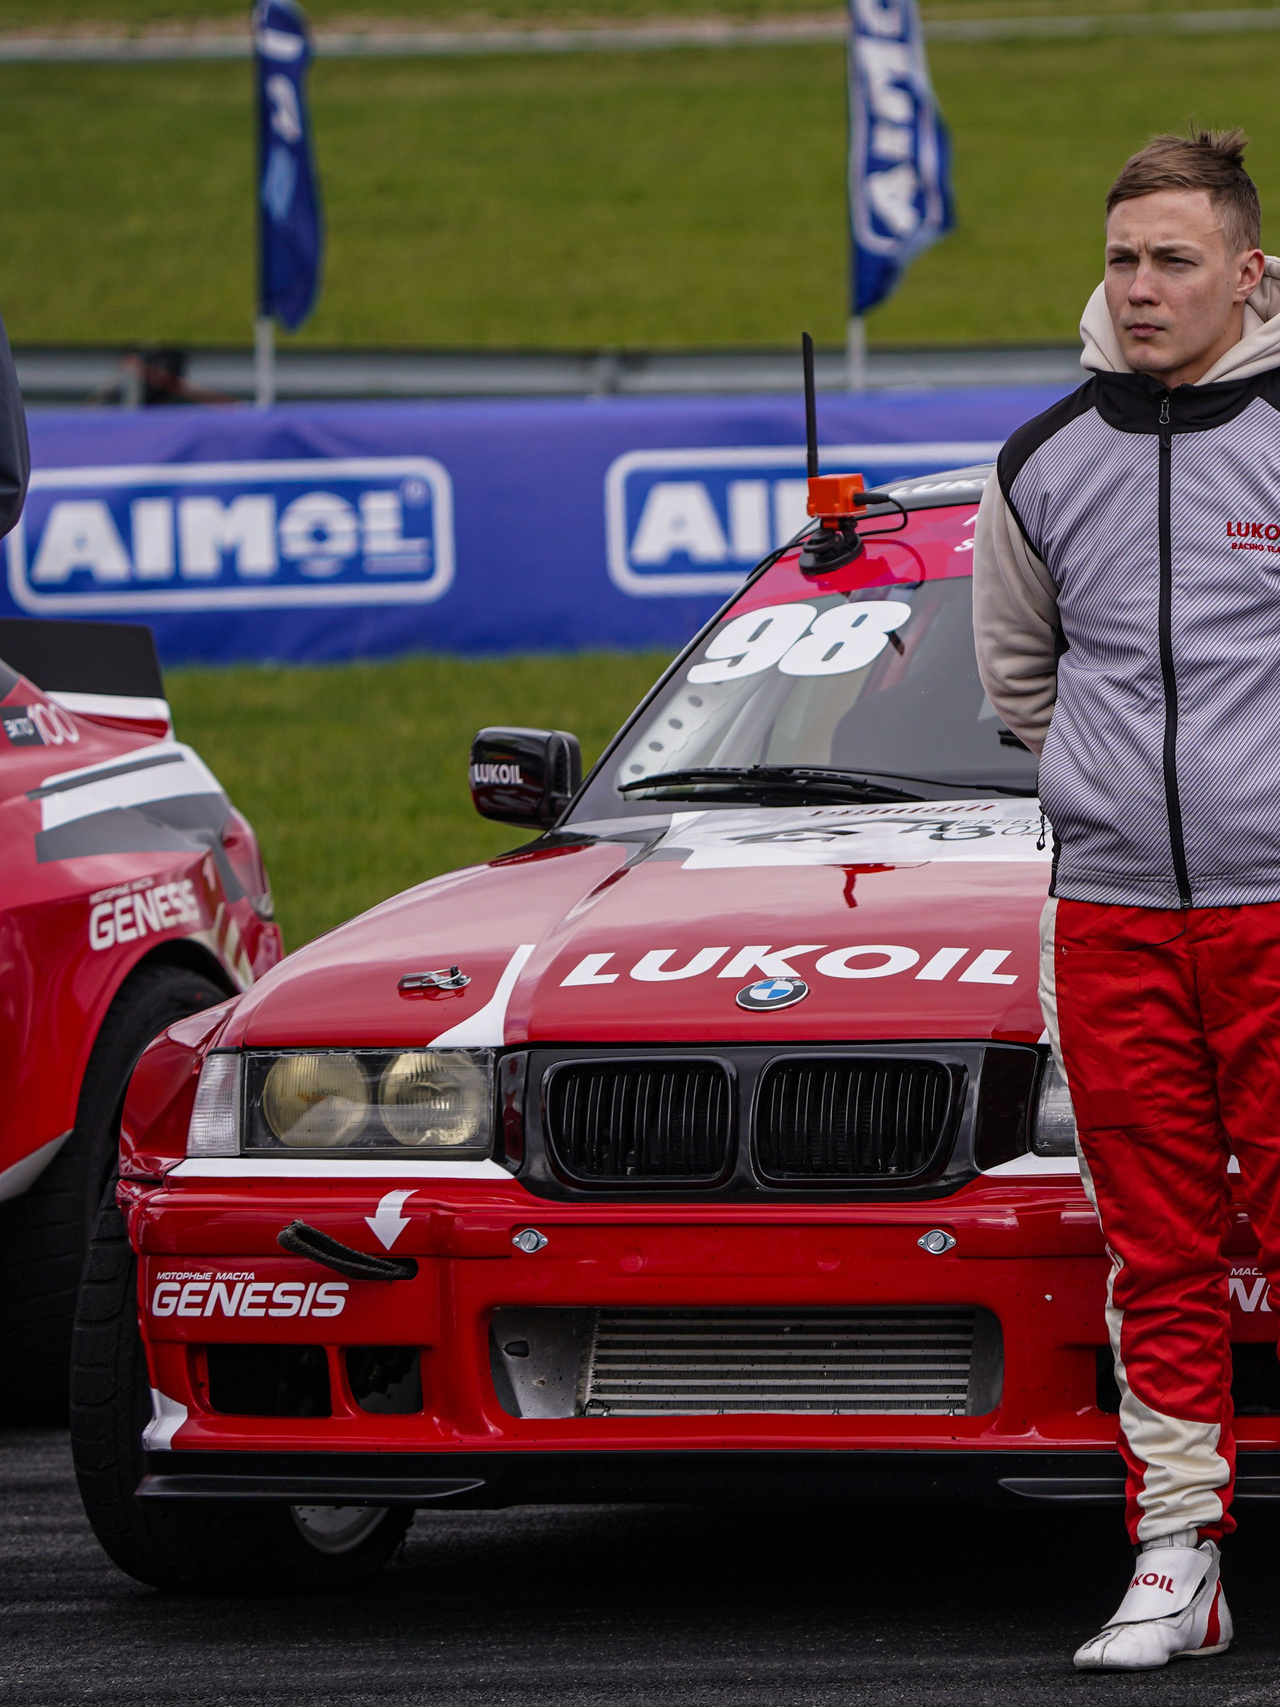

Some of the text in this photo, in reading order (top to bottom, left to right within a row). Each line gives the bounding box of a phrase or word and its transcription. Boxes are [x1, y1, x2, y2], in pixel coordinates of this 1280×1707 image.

[31, 492, 430, 583] AIMOL
[1231, 542, 1264, 551] RACING
[687, 601, 912, 684] 98
[27, 703, 79, 746] 100
[473, 763, 523, 786] LUKOIL
[89, 879, 200, 951] GENESIS
[559, 945, 1019, 987] LUKOIL
[156, 1271, 255, 1281] МОТОРНЫЕ МАСЛА
[1230, 1267, 1263, 1276] МАС
[152, 1282, 349, 1317] GENESIS
[1129, 1572, 1174, 1594] KOIL
